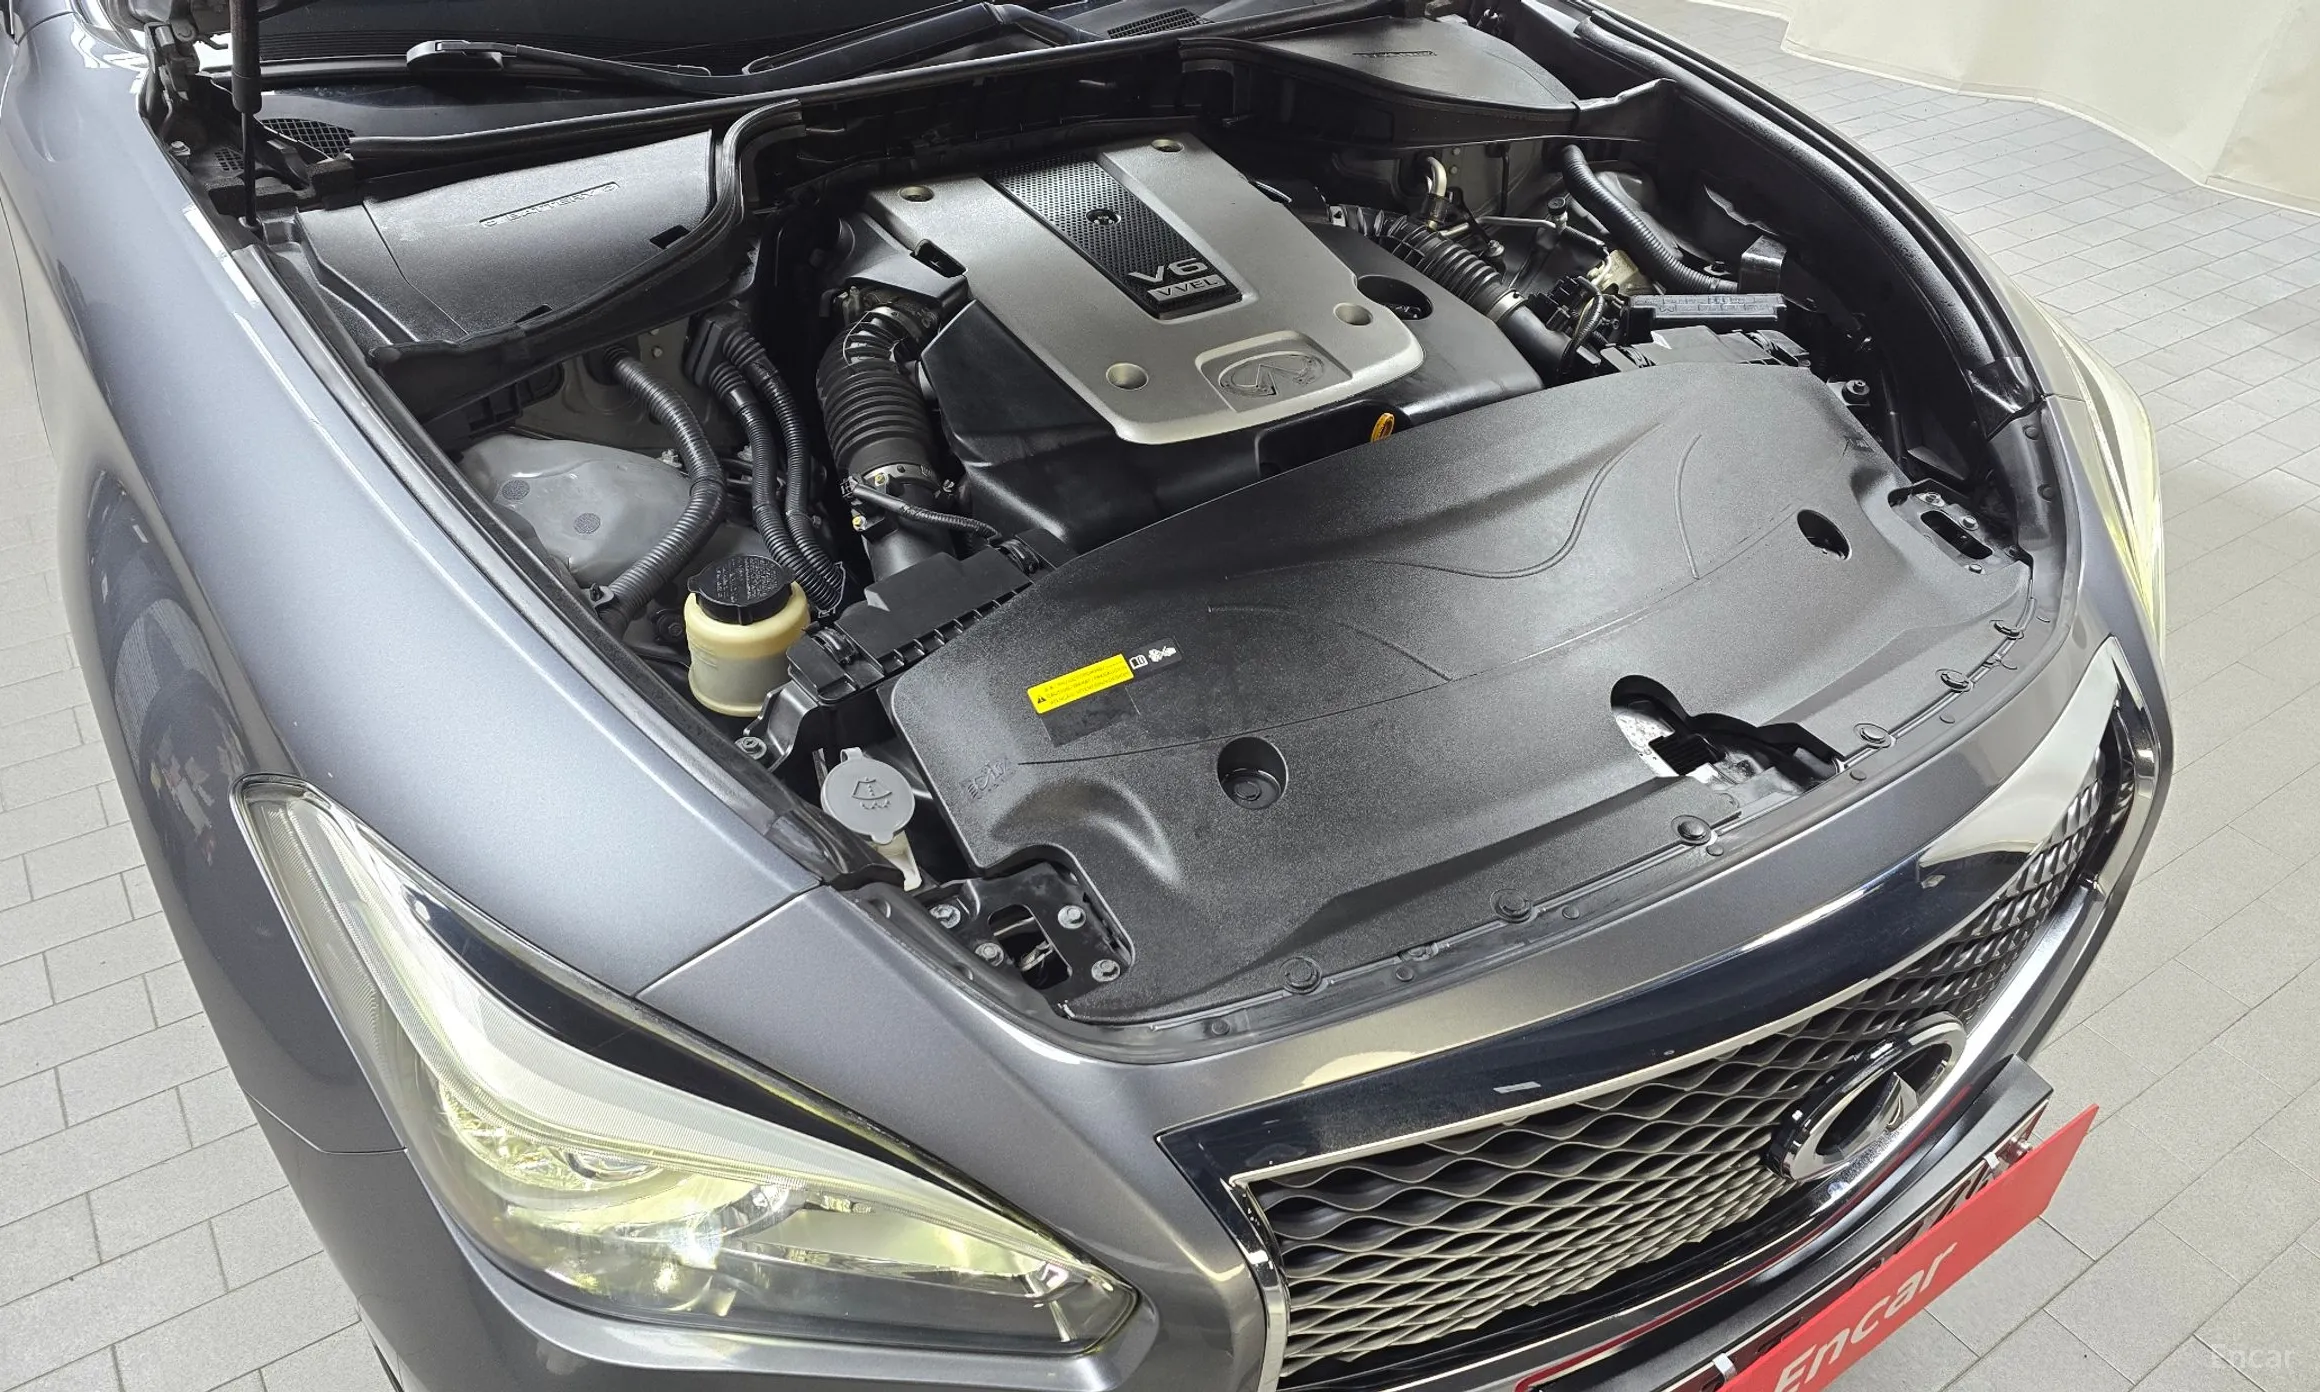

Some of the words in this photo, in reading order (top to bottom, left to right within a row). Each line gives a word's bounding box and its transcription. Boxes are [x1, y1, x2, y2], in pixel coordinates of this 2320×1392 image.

[506, 190, 594, 221] BATTERY
[1128, 258, 1208, 283] V6
[1156, 279, 1218, 296] VVEL
[1773, 1242, 1958, 1392] Encar
